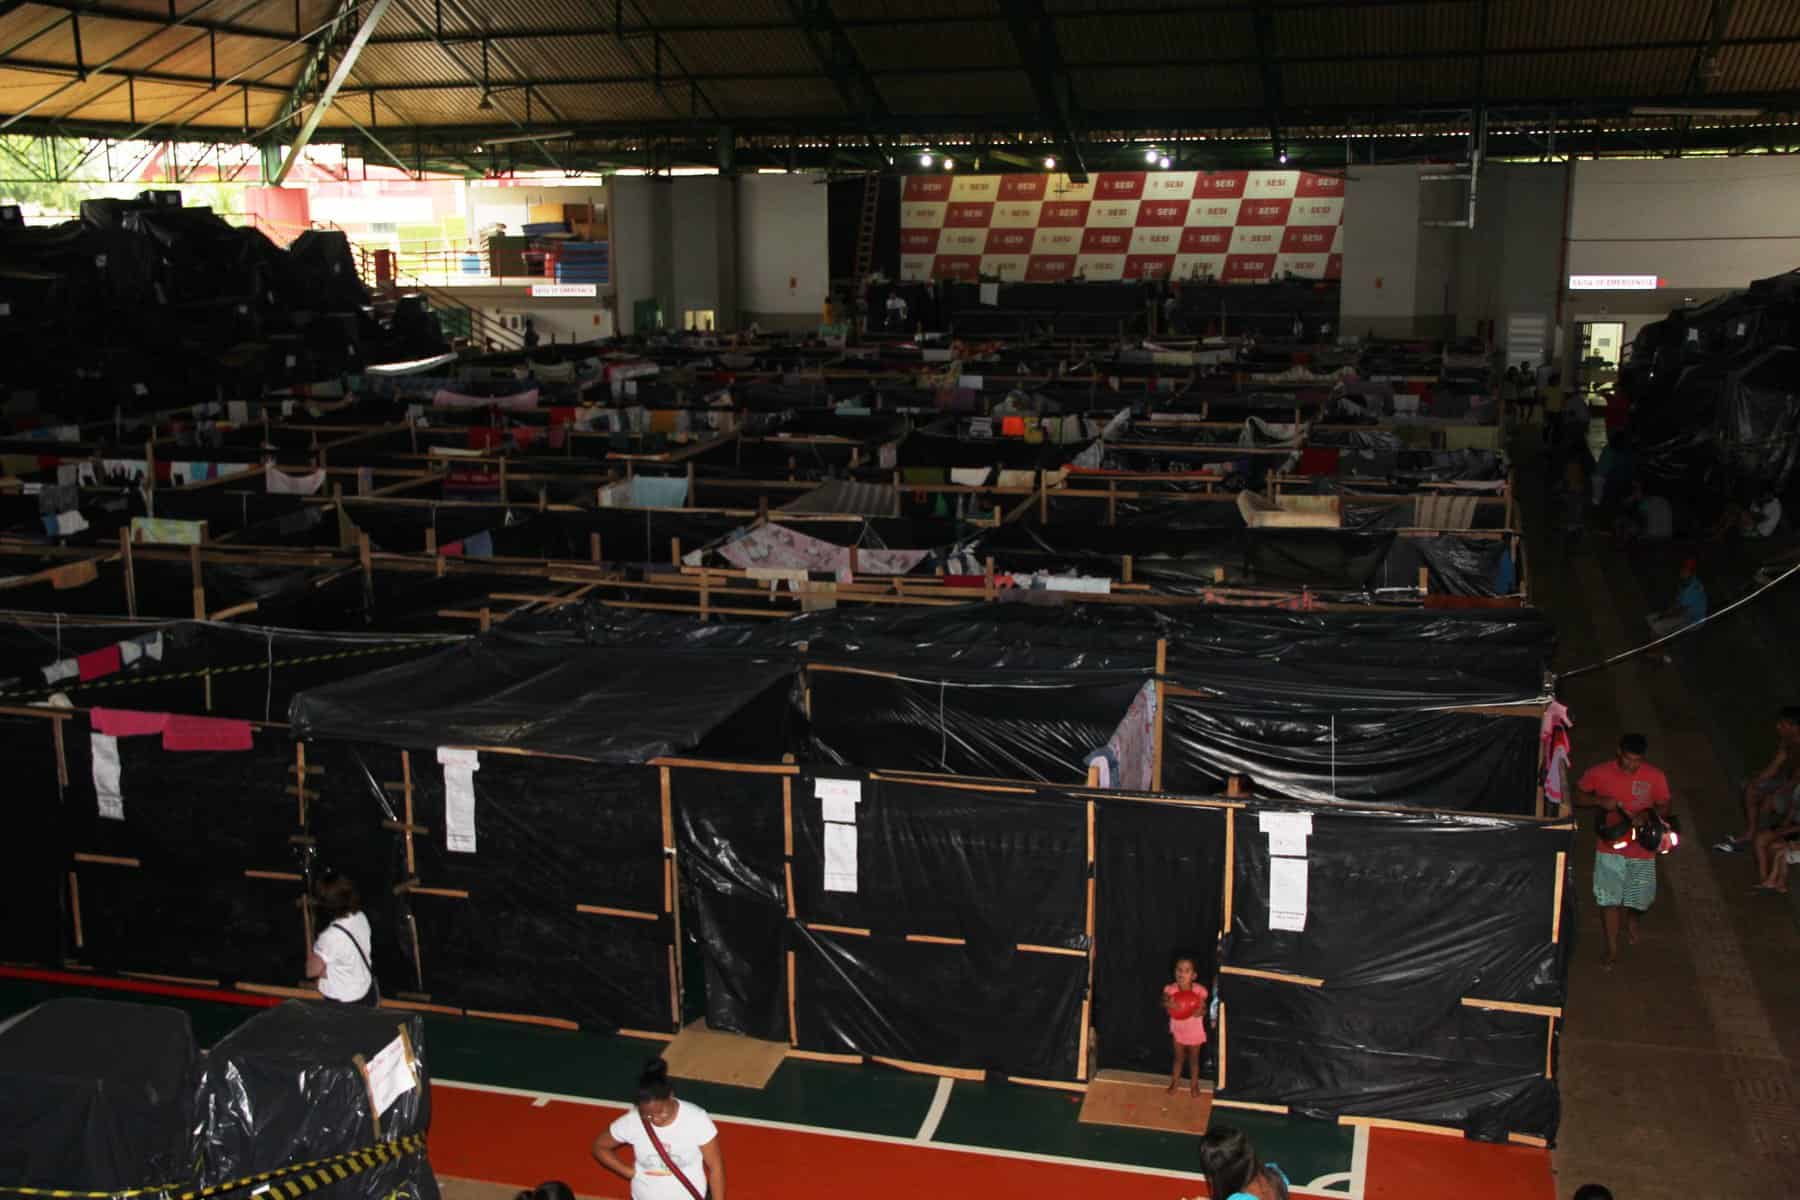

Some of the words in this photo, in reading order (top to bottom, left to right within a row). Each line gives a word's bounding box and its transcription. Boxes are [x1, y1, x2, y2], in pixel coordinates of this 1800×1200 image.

[1215, 180, 1235, 188] SESI
[1317, 178, 1338, 186] SESI
[1156, 208, 1176, 216] SESI
